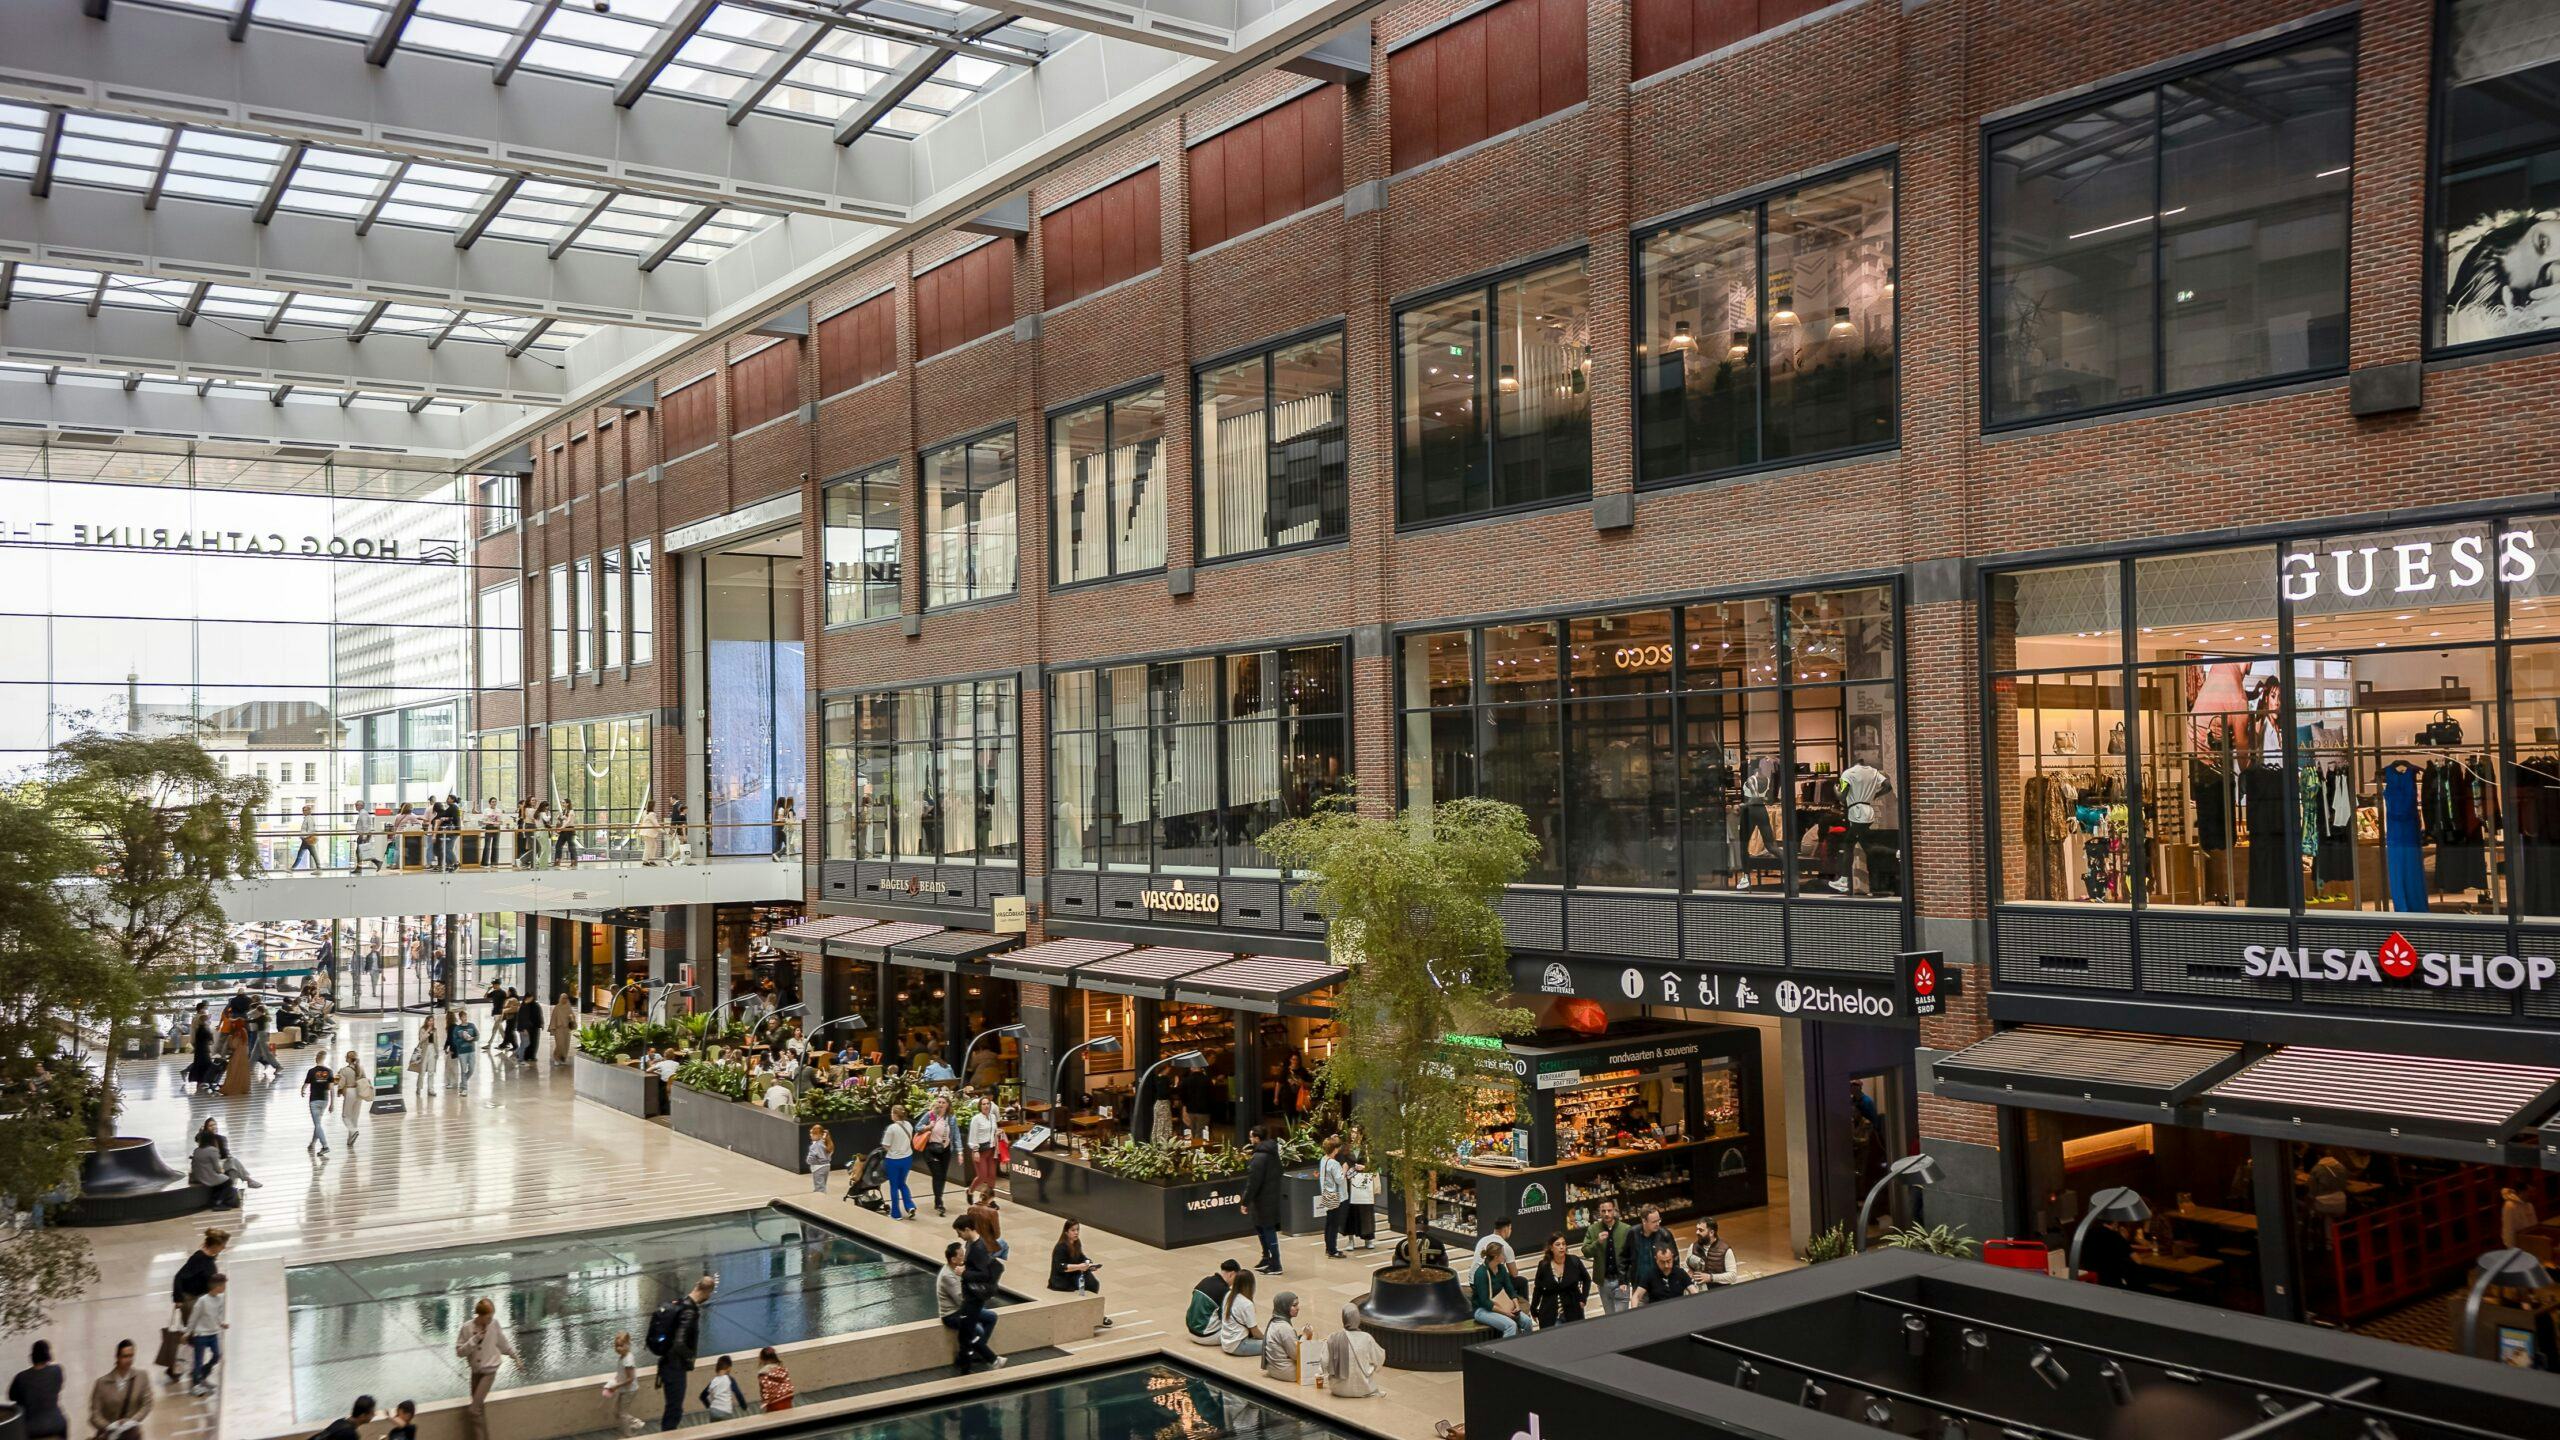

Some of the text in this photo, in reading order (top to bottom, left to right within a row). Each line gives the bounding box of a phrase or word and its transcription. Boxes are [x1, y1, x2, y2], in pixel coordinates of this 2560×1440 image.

[2283, 529, 2537, 601] GUESS
[880, 878, 910, 891] BAGELS
[919, 881, 946, 893] BEANS
[1141, 890, 1220, 913] VASCOBELO
[2243, 944, 2557, 991] SALSA SHOP
[1803, 985, 1894, 1017] 2theloo
[1915, 995, 1936, 1005] SALSA
[1917, 1004, 1935, 1014] SHOP
[1609, 1044, 1699, 1064] rondvaarten & souvenirs
[1187, 1194, 1241, 1211] VASCOBELO
